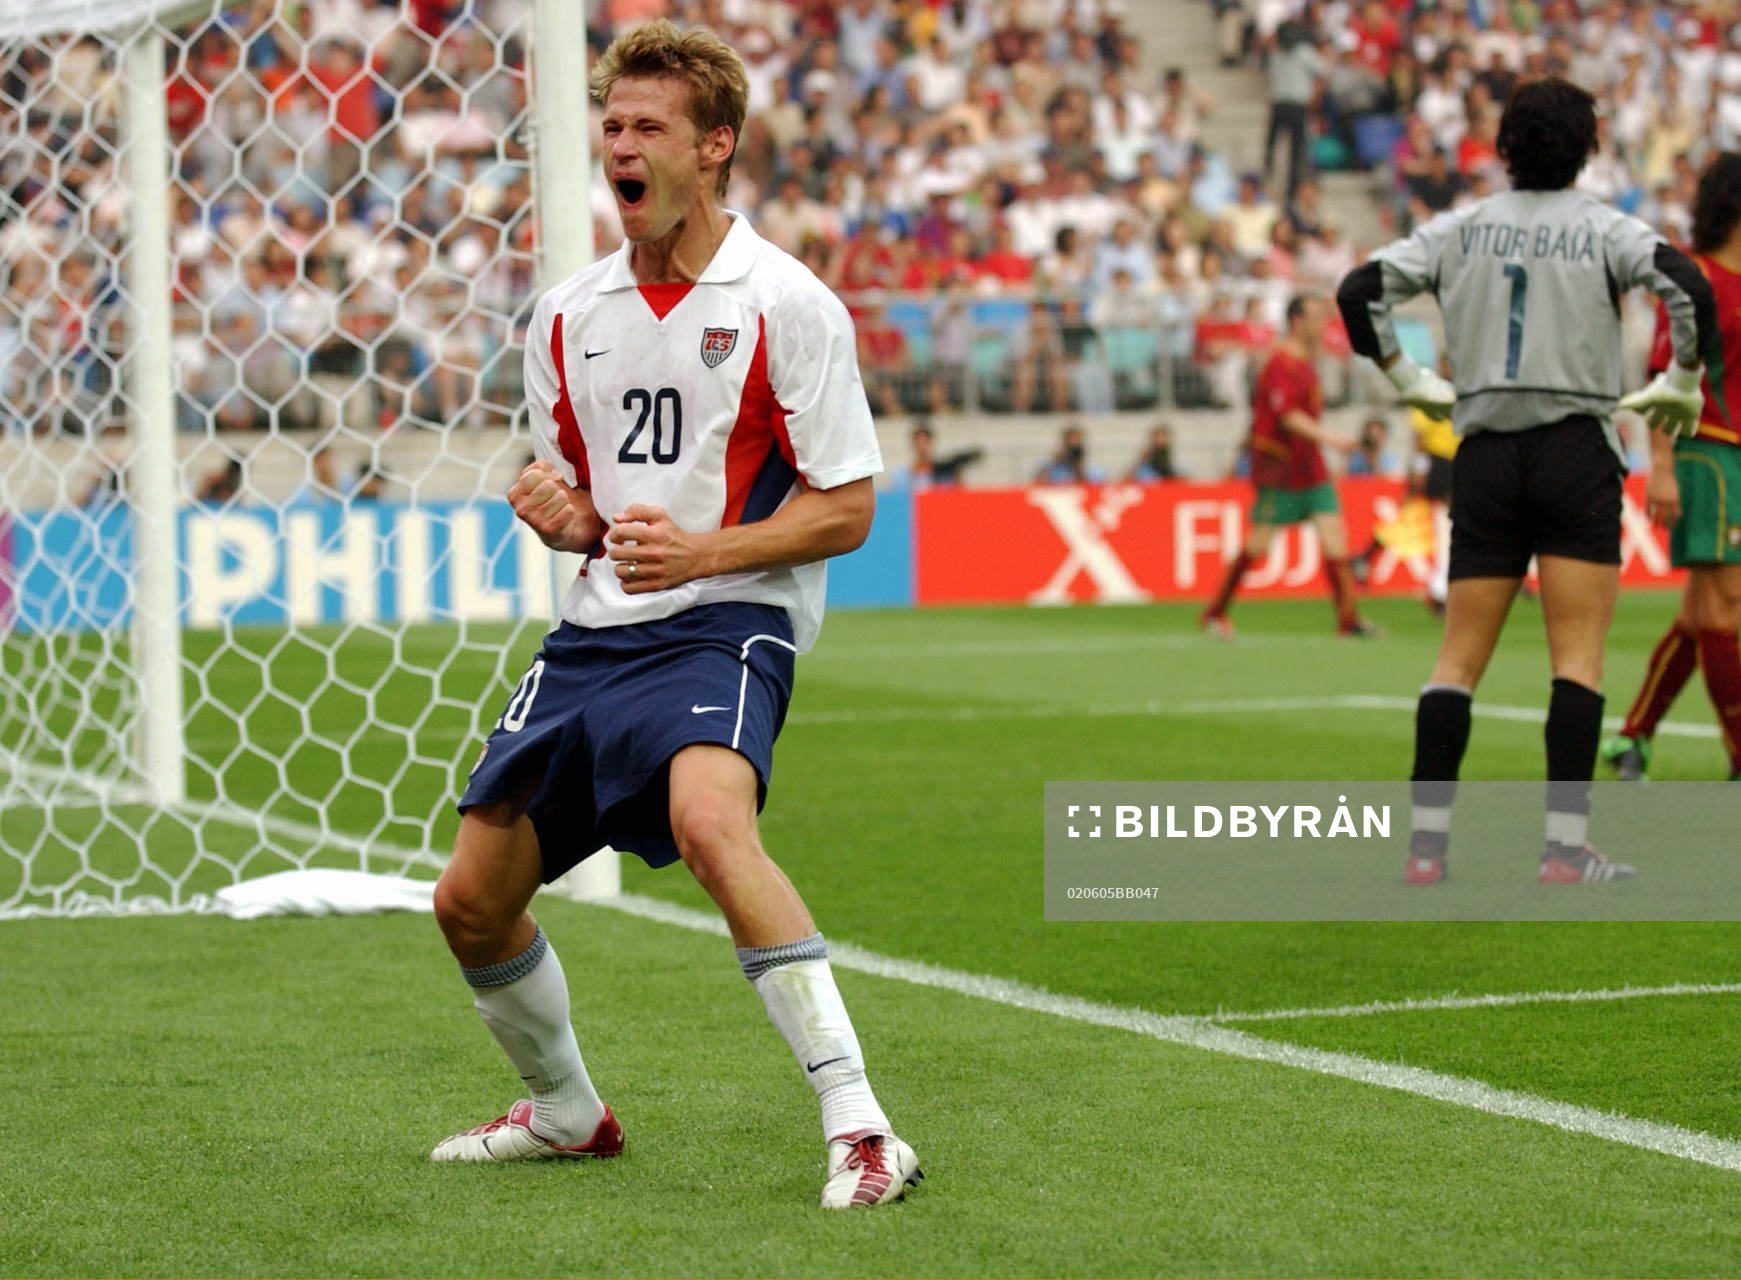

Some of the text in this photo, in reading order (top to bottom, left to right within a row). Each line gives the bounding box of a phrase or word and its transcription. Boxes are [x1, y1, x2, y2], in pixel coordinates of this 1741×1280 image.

[1459, 223, 1529, 257] VITOR
[1503, 263, 1528, 379] 1
[618, 387, 682, 465] 20
[493, 660, 545, 733] 0
